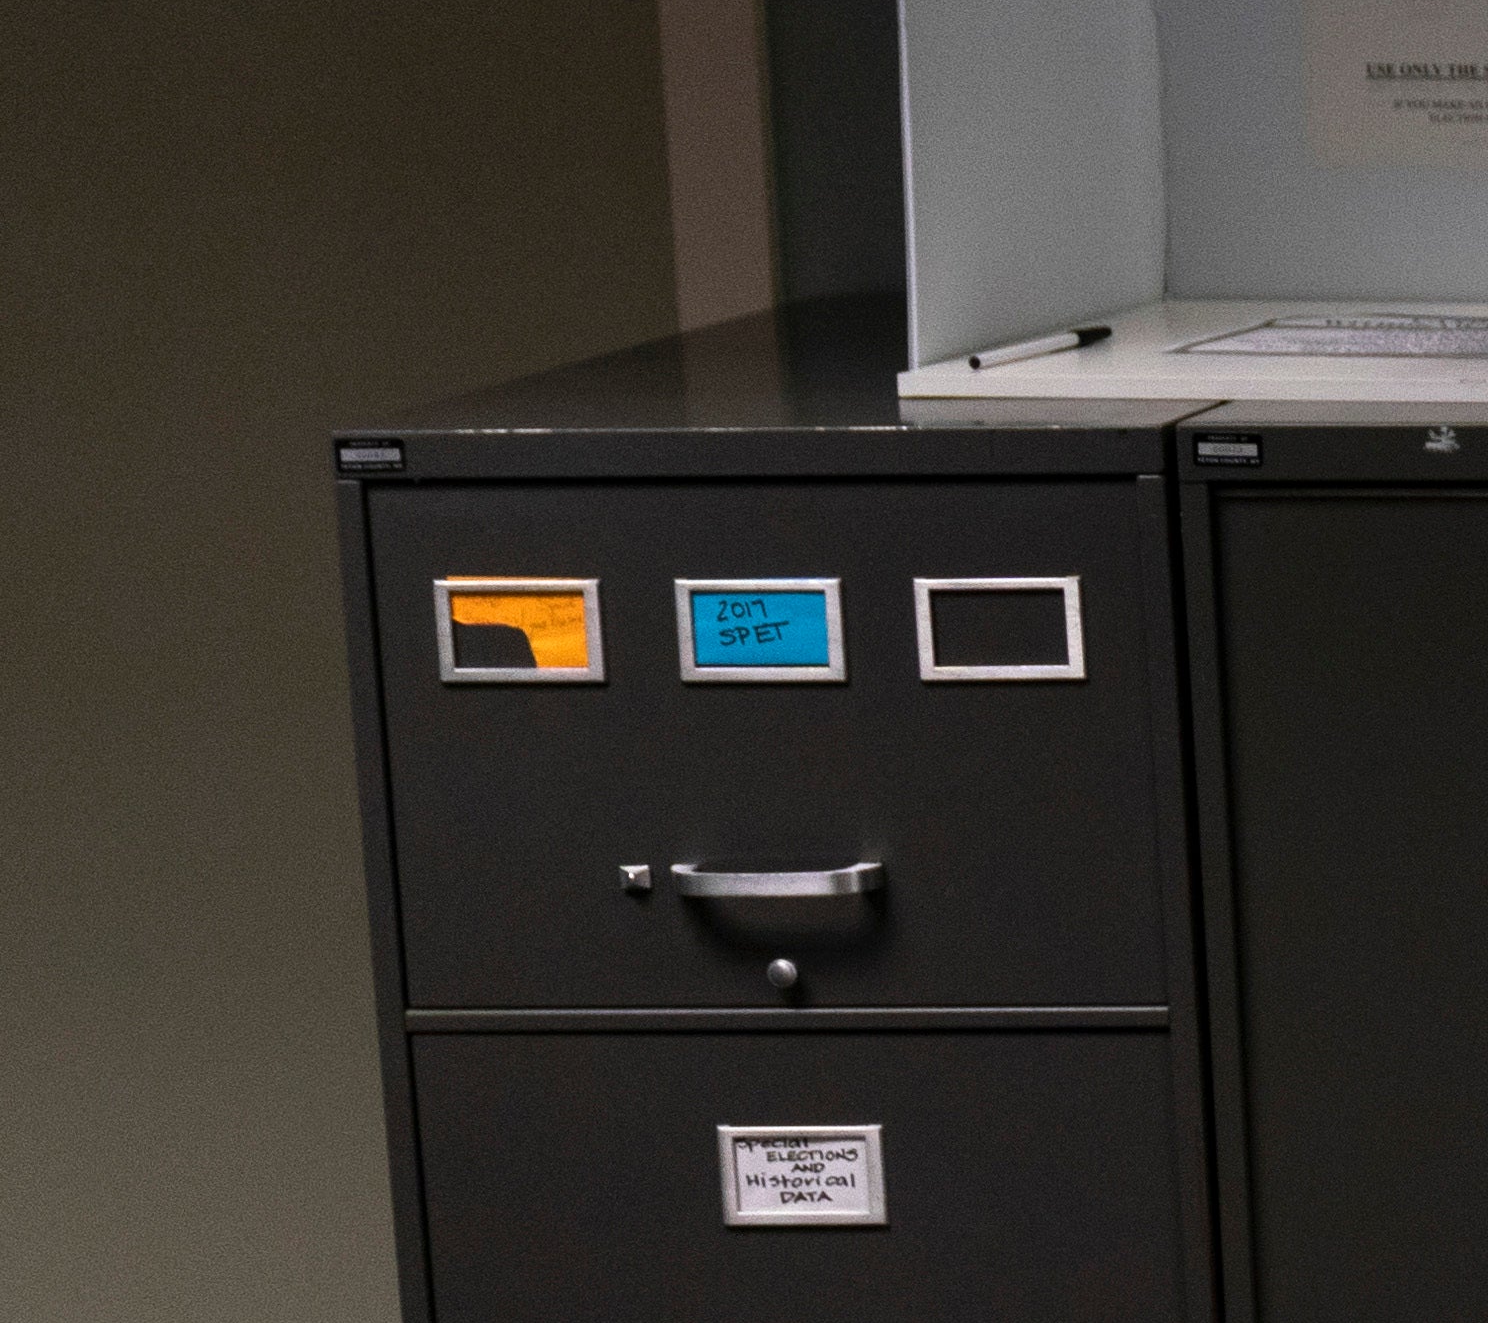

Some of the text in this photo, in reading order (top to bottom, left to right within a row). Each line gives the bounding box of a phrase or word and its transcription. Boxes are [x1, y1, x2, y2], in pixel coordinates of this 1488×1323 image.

[1365, 62, 1395, 79] USE
[1399, 63, 1443, 79] ONLY
[1447, 63, 1478, 79] THE
[716, 598, 768, 624] 2017
[718, 620, 789, 648] SPET
[766, 1147, 859, 1163] ELECTIONS
[790, 1162, 827, 1174] AND
[746, 1171, 857, 1189] Historical
[779, 1190, 834, 1205] DATA
